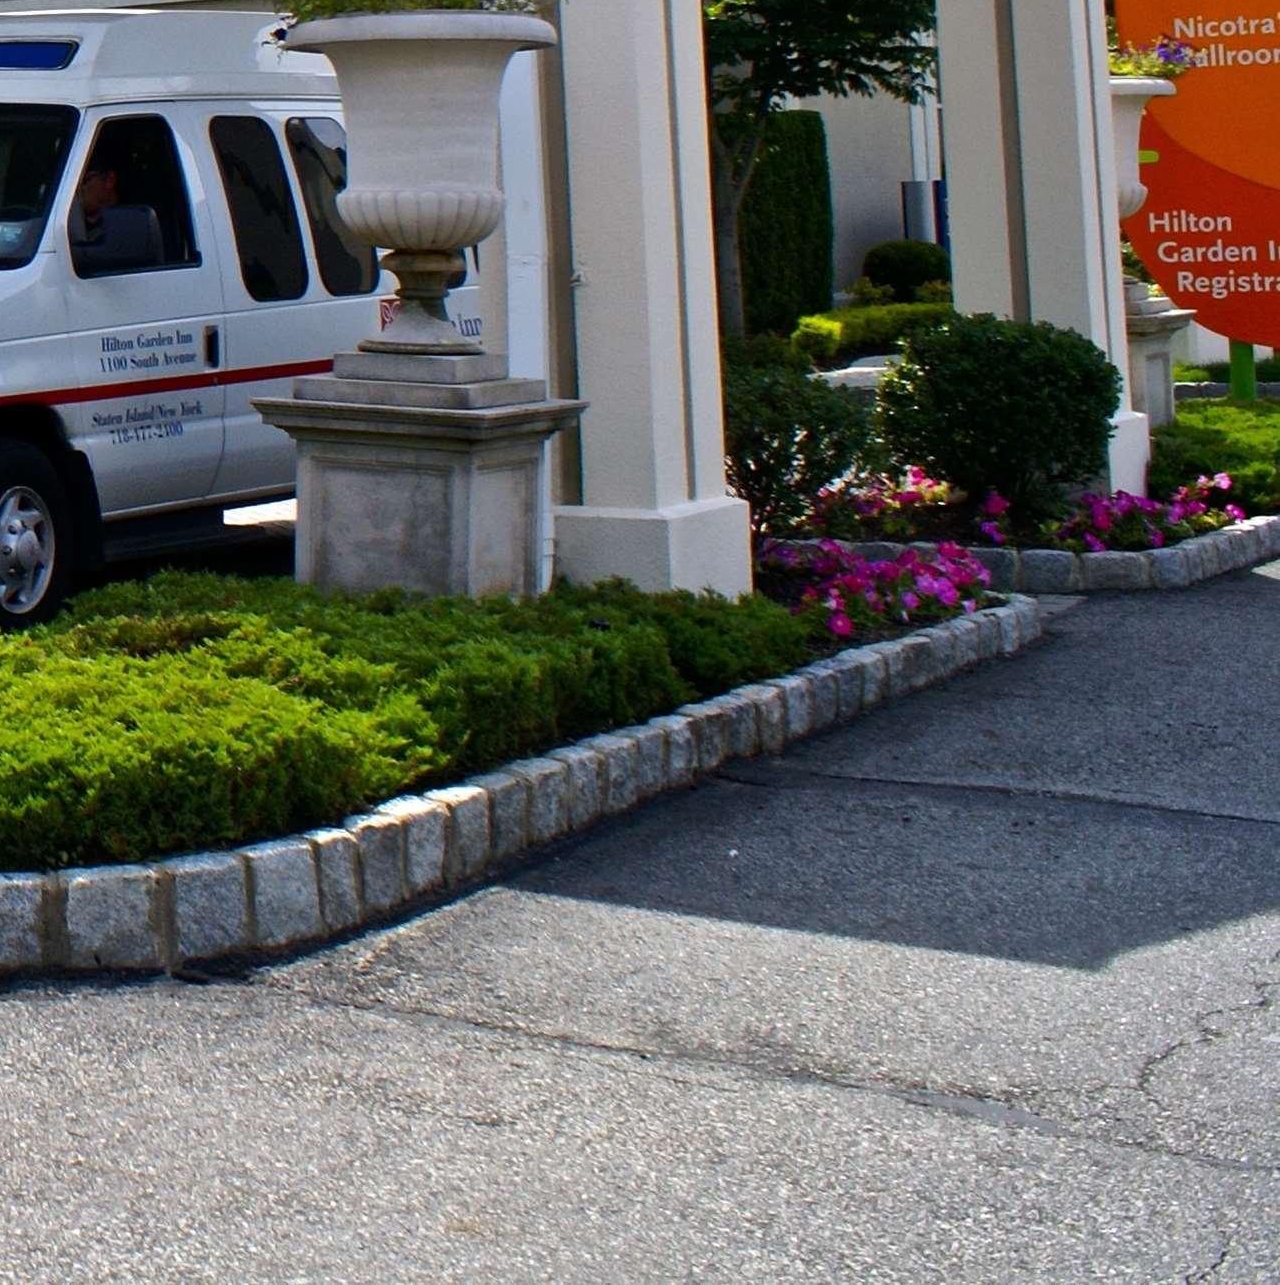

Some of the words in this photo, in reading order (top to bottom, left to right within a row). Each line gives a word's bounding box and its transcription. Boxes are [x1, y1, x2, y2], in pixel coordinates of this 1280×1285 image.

[1149, 210, 1232, 233] Hilton
[1157, 239, 1257, 263] Garden
[1268, 240, 1280, 261] I
[101, 336, 134, 352] Hilton
[137, 332, 173, 348] Garden
[176, 330, 193, 344] Inn
[100, 356, 128, 373] 1100
[130, 352, 159, 369] South
[163, 352, 197, 365] Avenue
[91, 412, 122, 427] Staten
[126, 405, 154, 423] Island
[180, 400, 203, 416] York
